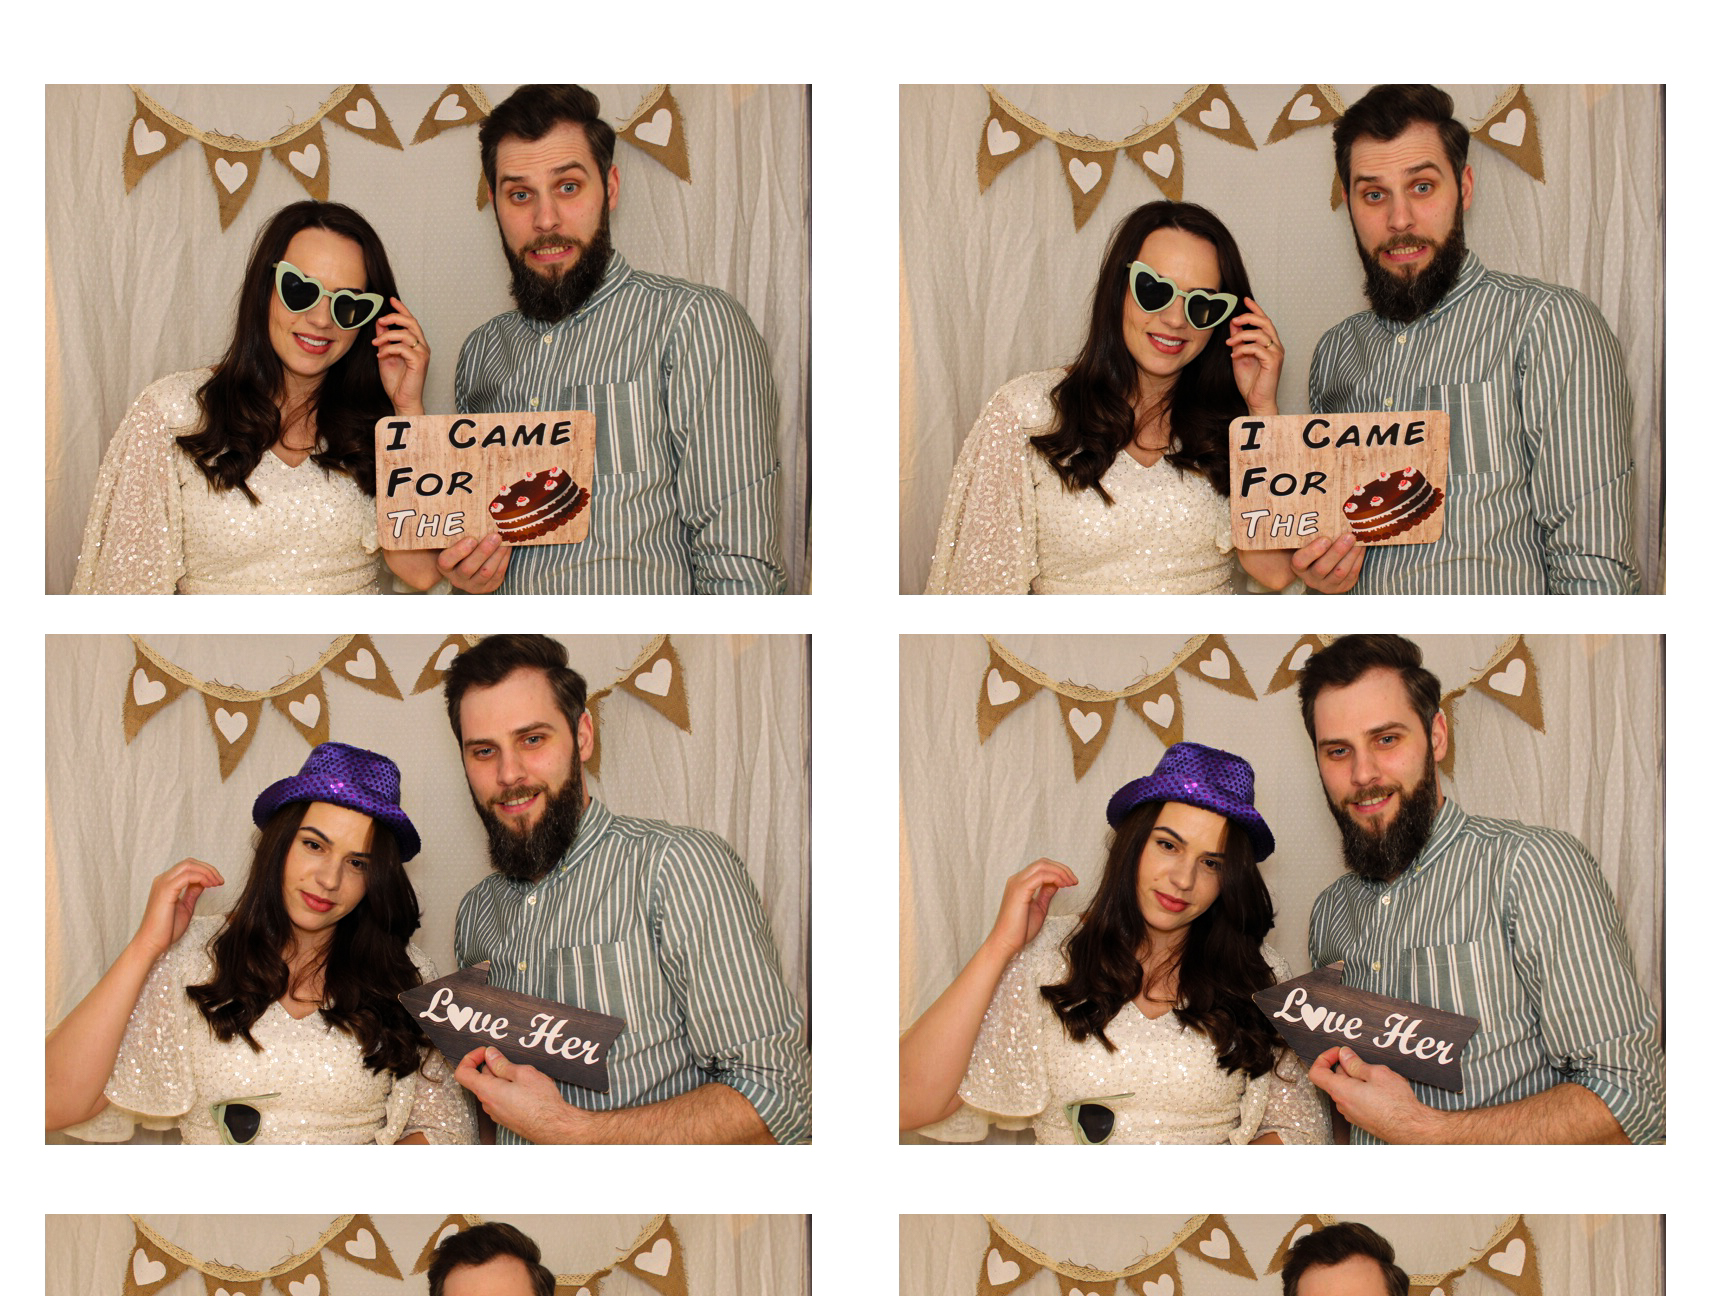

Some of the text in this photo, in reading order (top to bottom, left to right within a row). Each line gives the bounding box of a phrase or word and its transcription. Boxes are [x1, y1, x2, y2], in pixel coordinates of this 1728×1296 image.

[386, 418, 571, 451] I CAME
[1240, 418, 1425, 451] I CAME
[387, 466, 473, 498] FOR
[1241, 466, 1327, 498] FOR
[386, 509, 465, 539] THE
[1240, 509, 1319, 539] THE
[518, 1013, 600, 1065] Her
[1372, 1013, 1454, 1065] Her
